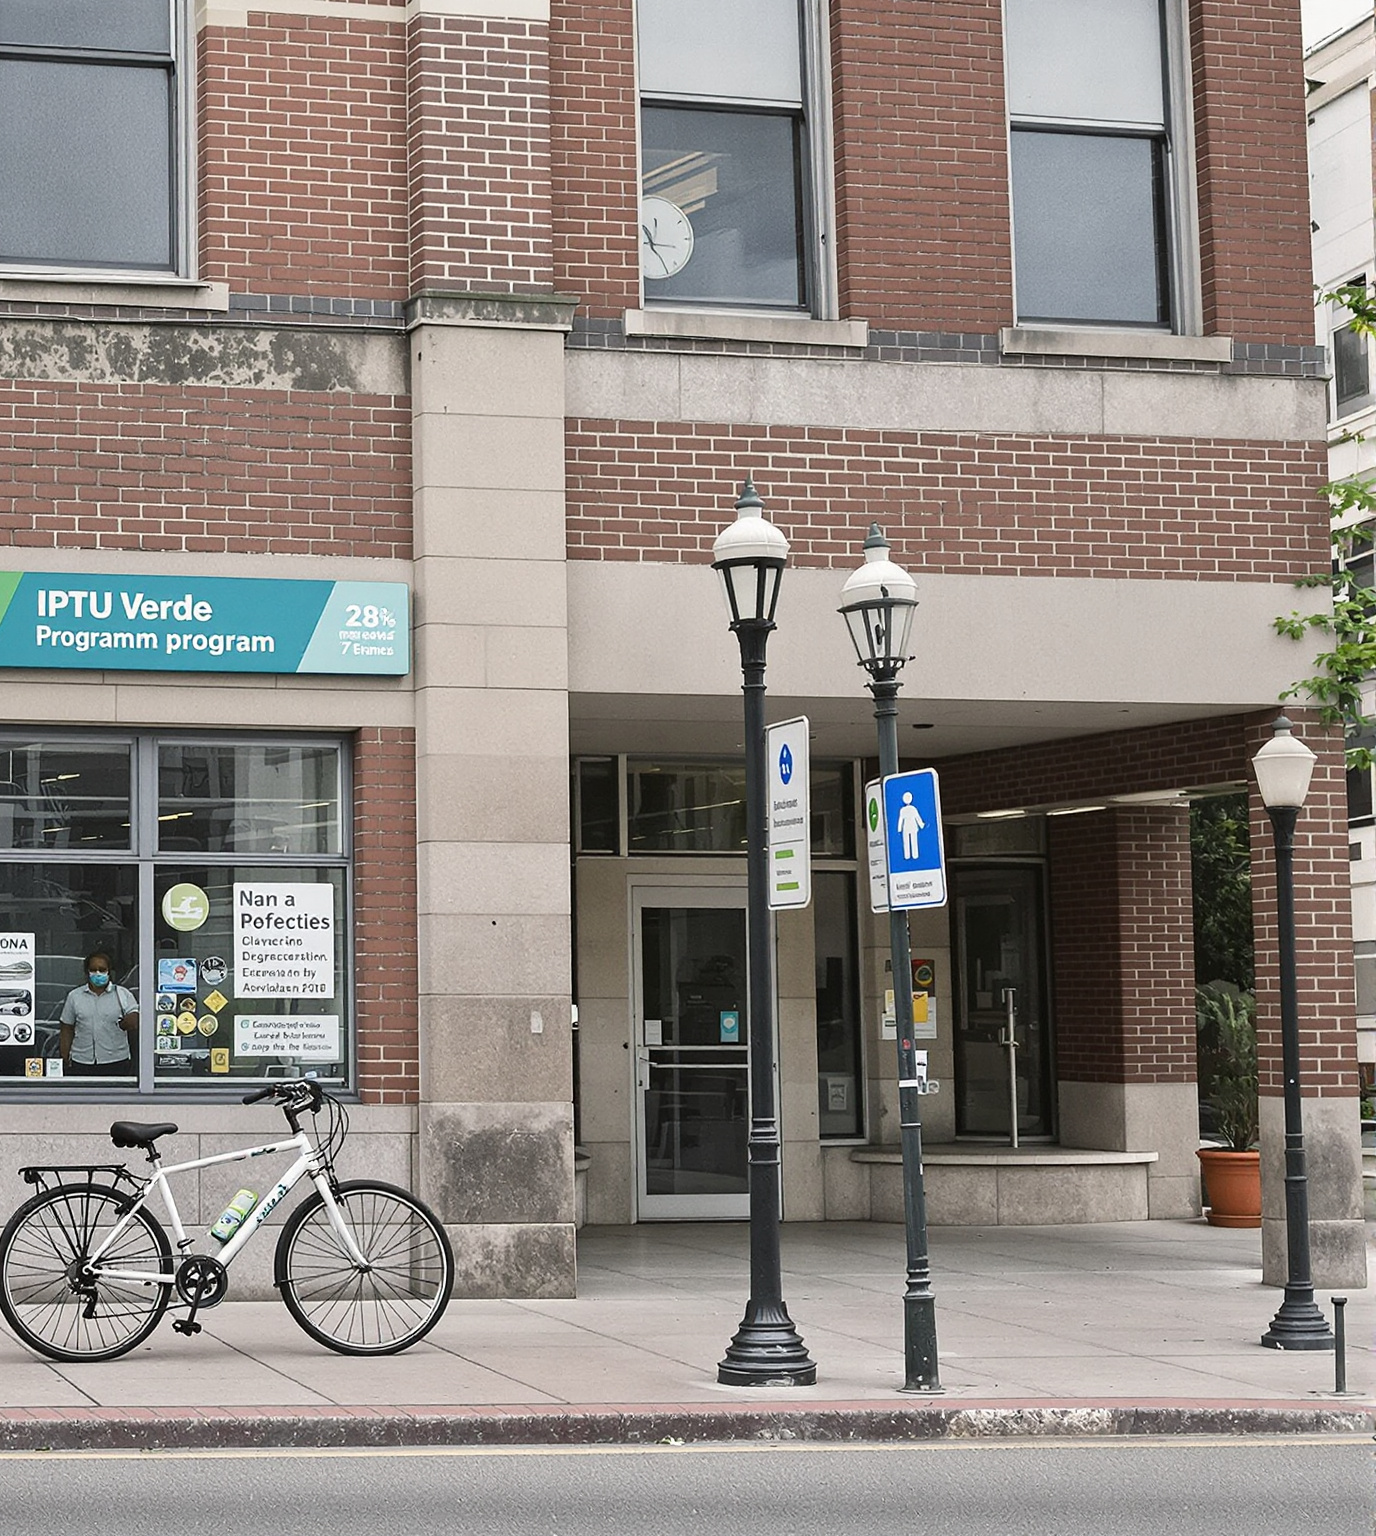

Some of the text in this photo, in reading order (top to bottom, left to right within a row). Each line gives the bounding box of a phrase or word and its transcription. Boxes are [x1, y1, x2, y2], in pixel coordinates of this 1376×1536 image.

[36, 589, 213, 622] IPTU Verde
[35, 625, 275, 656] Programm program
[240, 890, 295, 907] Nan a
